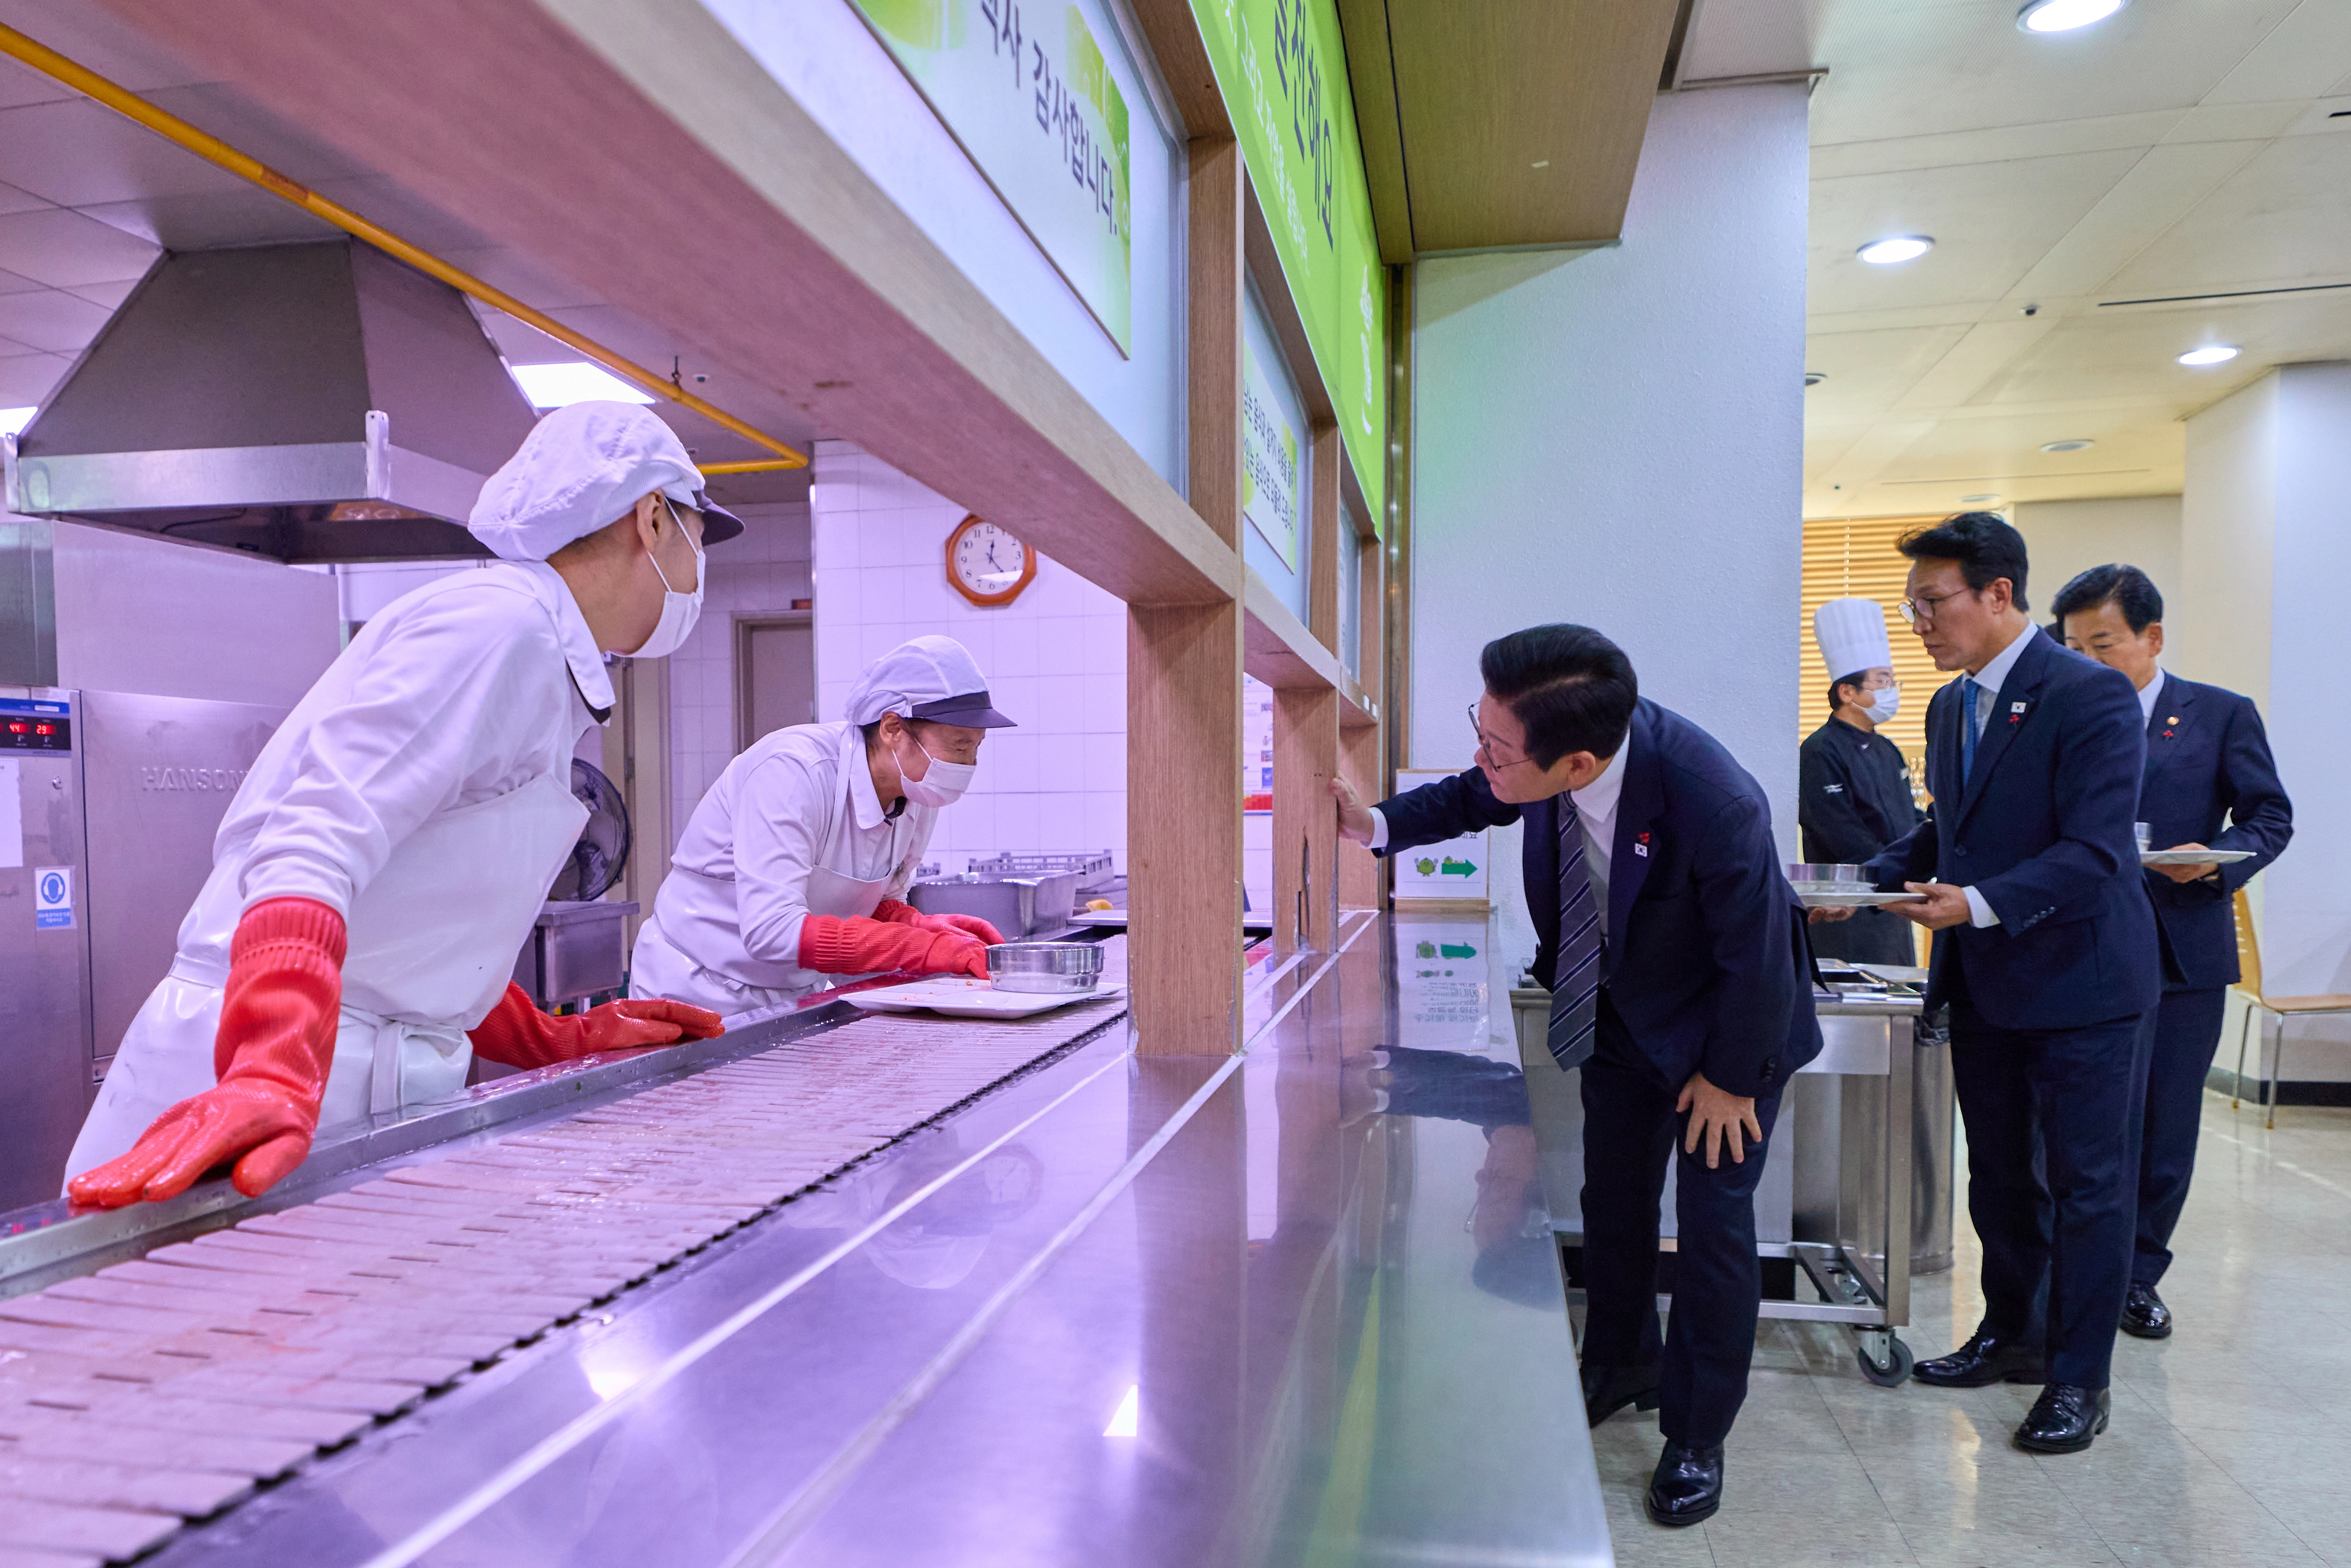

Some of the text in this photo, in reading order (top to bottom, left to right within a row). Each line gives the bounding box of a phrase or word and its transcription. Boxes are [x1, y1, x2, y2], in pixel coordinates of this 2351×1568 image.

[1241, 12, 1264, 128] 그리고
[1265, 99, 1285, 203] 자연을
[1034, 39, 1117, 236] 감사합니다.
[1254, 395, 1266, 445] 음식과
[1255, 449, 1270, 504] 음식으로
[974, 530, 981, 538] 11
[987, 525, 994, 534] 12
[964, 541, 973, 549] 10
[1016, 551, 1022, 559] 3
[966, 569, 972, 578] 8
[36, 725, 47, 734] 29
[141, 768, 249, 792] HANSON
